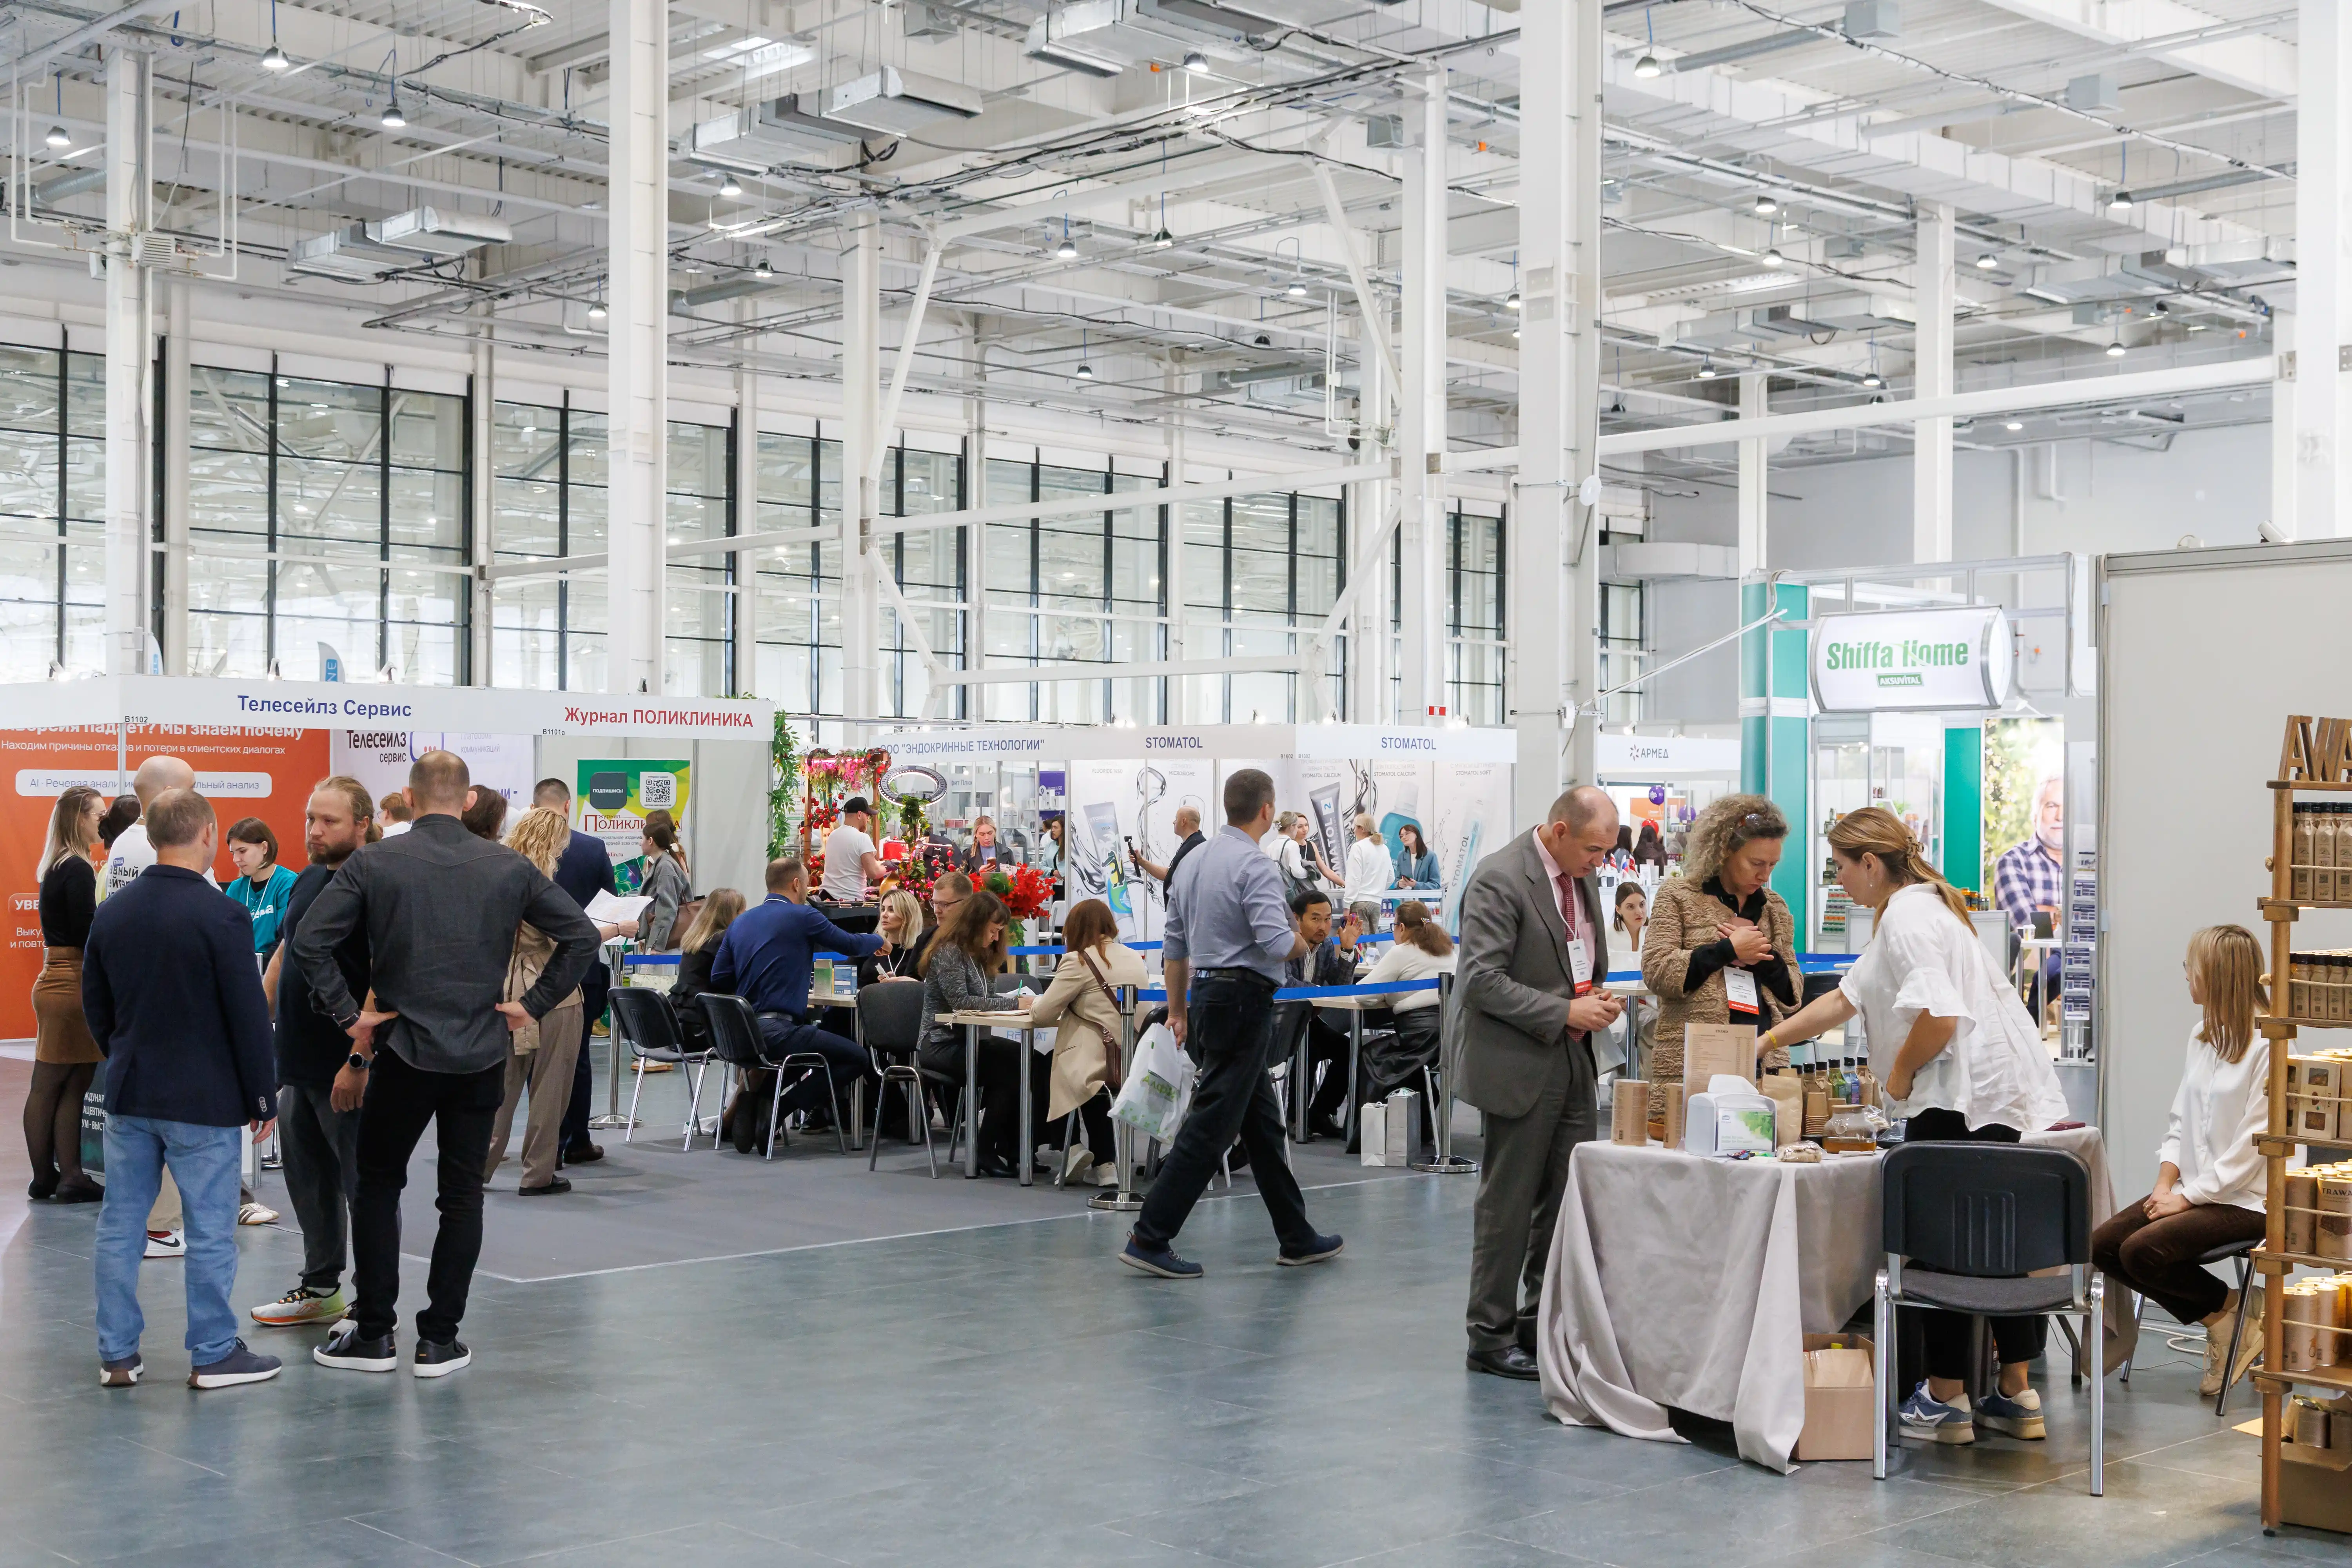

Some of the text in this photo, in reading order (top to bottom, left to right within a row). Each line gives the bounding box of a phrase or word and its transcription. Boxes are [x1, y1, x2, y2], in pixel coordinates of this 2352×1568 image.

[1827, 640, 1968, 670] Shiffa Home
[237, 695, 412, 719] Телесейлз Сервис
[564, 707, 753, 728] Журнал ПОЛИКЛИНИКА
[84, 723, 156, 735] падет?
[191, 725, 241, 736] знаем
[245, 726, 304, 740] почему
[2, 740, 46, 751] Находим
[49, 742, 92, 752] причины
[143, 745, 178, 754] потери
[243, 746, 285, 755] диалогах
[461, 744, 500, 755] коммуникаций
[902, 741, 974, 755] "ЭНДОКРИННЫЕ
[976, 739, 1045, 751] ТЕХНОЛОГИИ"
[1145, 737, 1203, 749] STOMATOL
[1381, 737, 1437, 750] STOMATOL
[380, 753, 406, 765] сервис
[1641, 748, 1669, 758] АРМЕД
[46, 779, 88, 788] Речевая
[1452, 835, 1469, 887] STOMATOL
[16, 927, 44, 938] Выку
[1007, 1030, 1049, 1042] REAT
